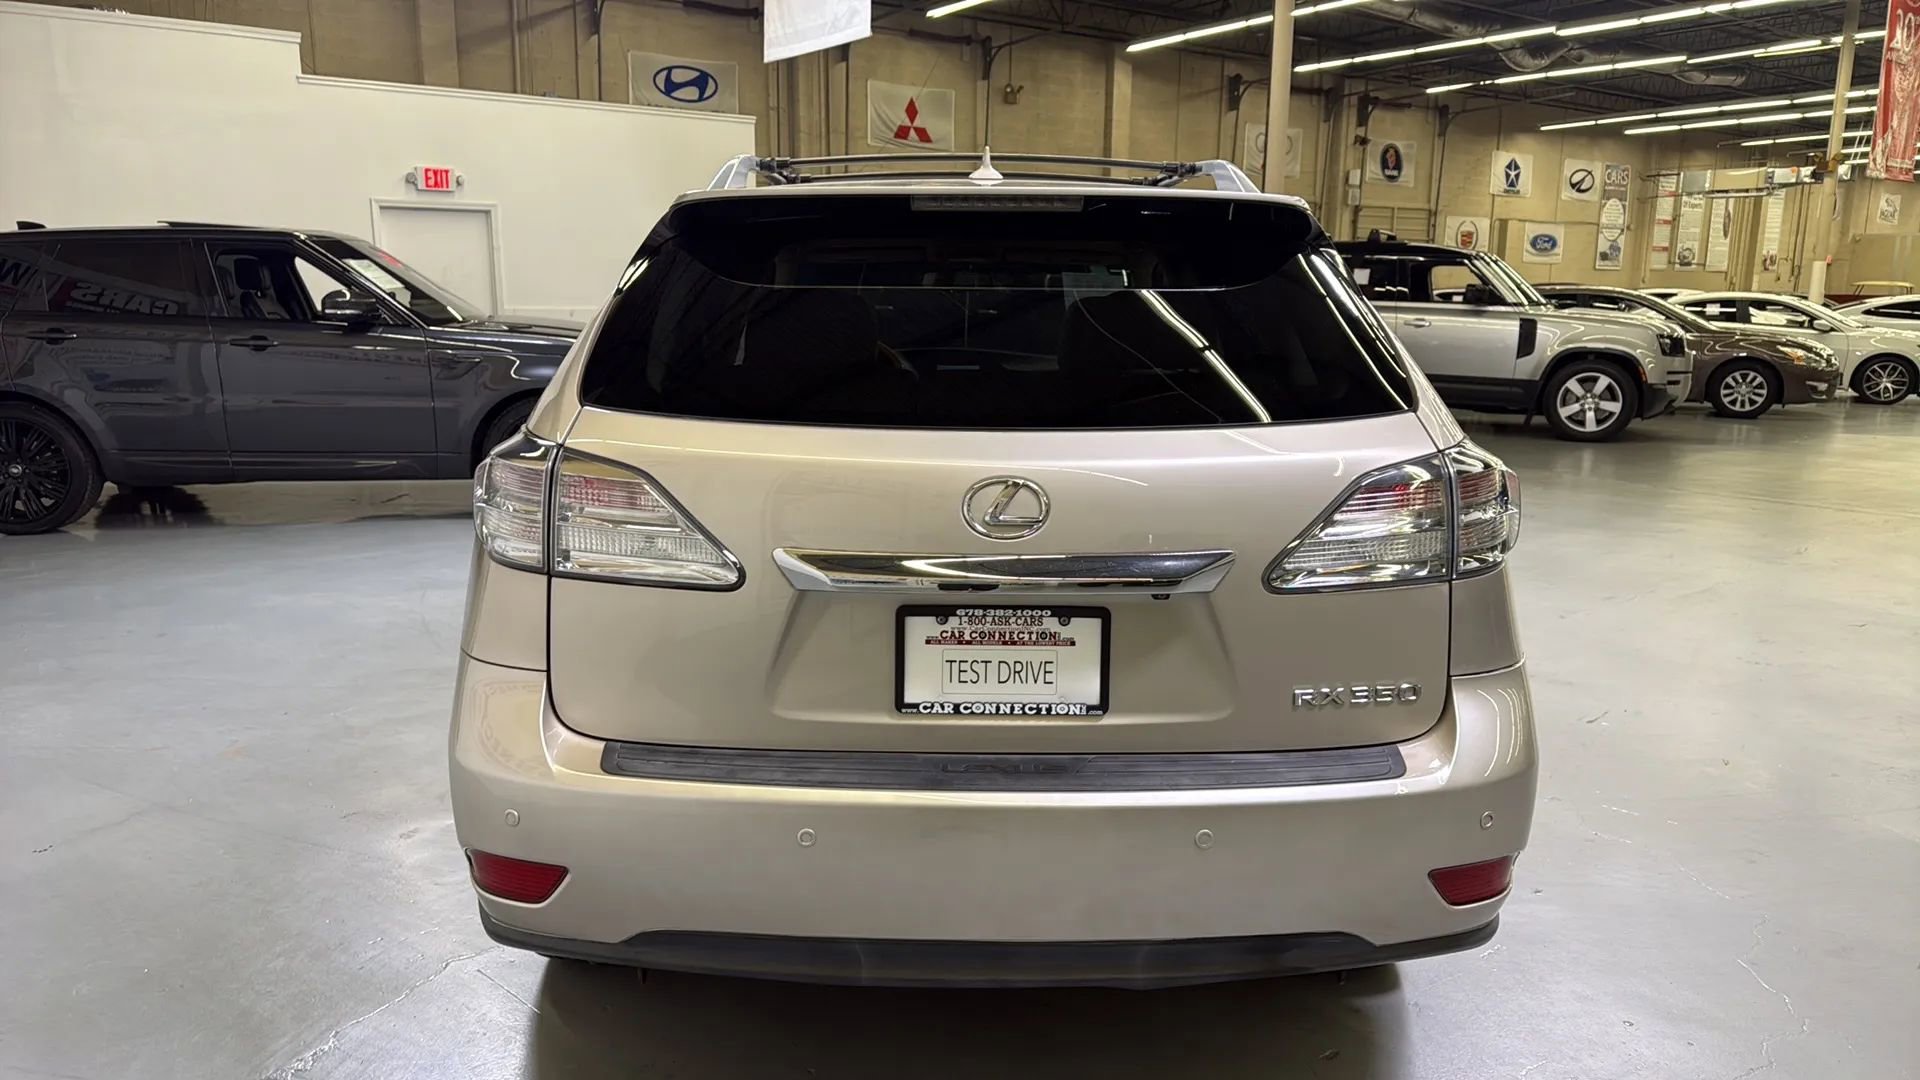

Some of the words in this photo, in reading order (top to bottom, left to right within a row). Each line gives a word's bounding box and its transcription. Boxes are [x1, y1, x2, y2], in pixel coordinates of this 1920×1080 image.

[424, 168, 449, 189] EXIT
[1605, 169, 1628, 185] CARS
[1536, 236, 1555, 250] Ford
[956, 609, 1052, 617] 678-382-1000
[957, 616, 1044, 627] 1-800-ASK-CARS
[940, 630, 965, 640] CAR
[969, 630, 1057, 641] CONNECTION
[945, 660, 992, 684] TEST
[998, 660, 1054, 684] DRIVE
[1293, 687, 1344, 706] RX
[1350, 683, 1421, 703] 350
[919, 702, 954, 714] CAR
[959, 703, 1081, 715] CONNECTION
